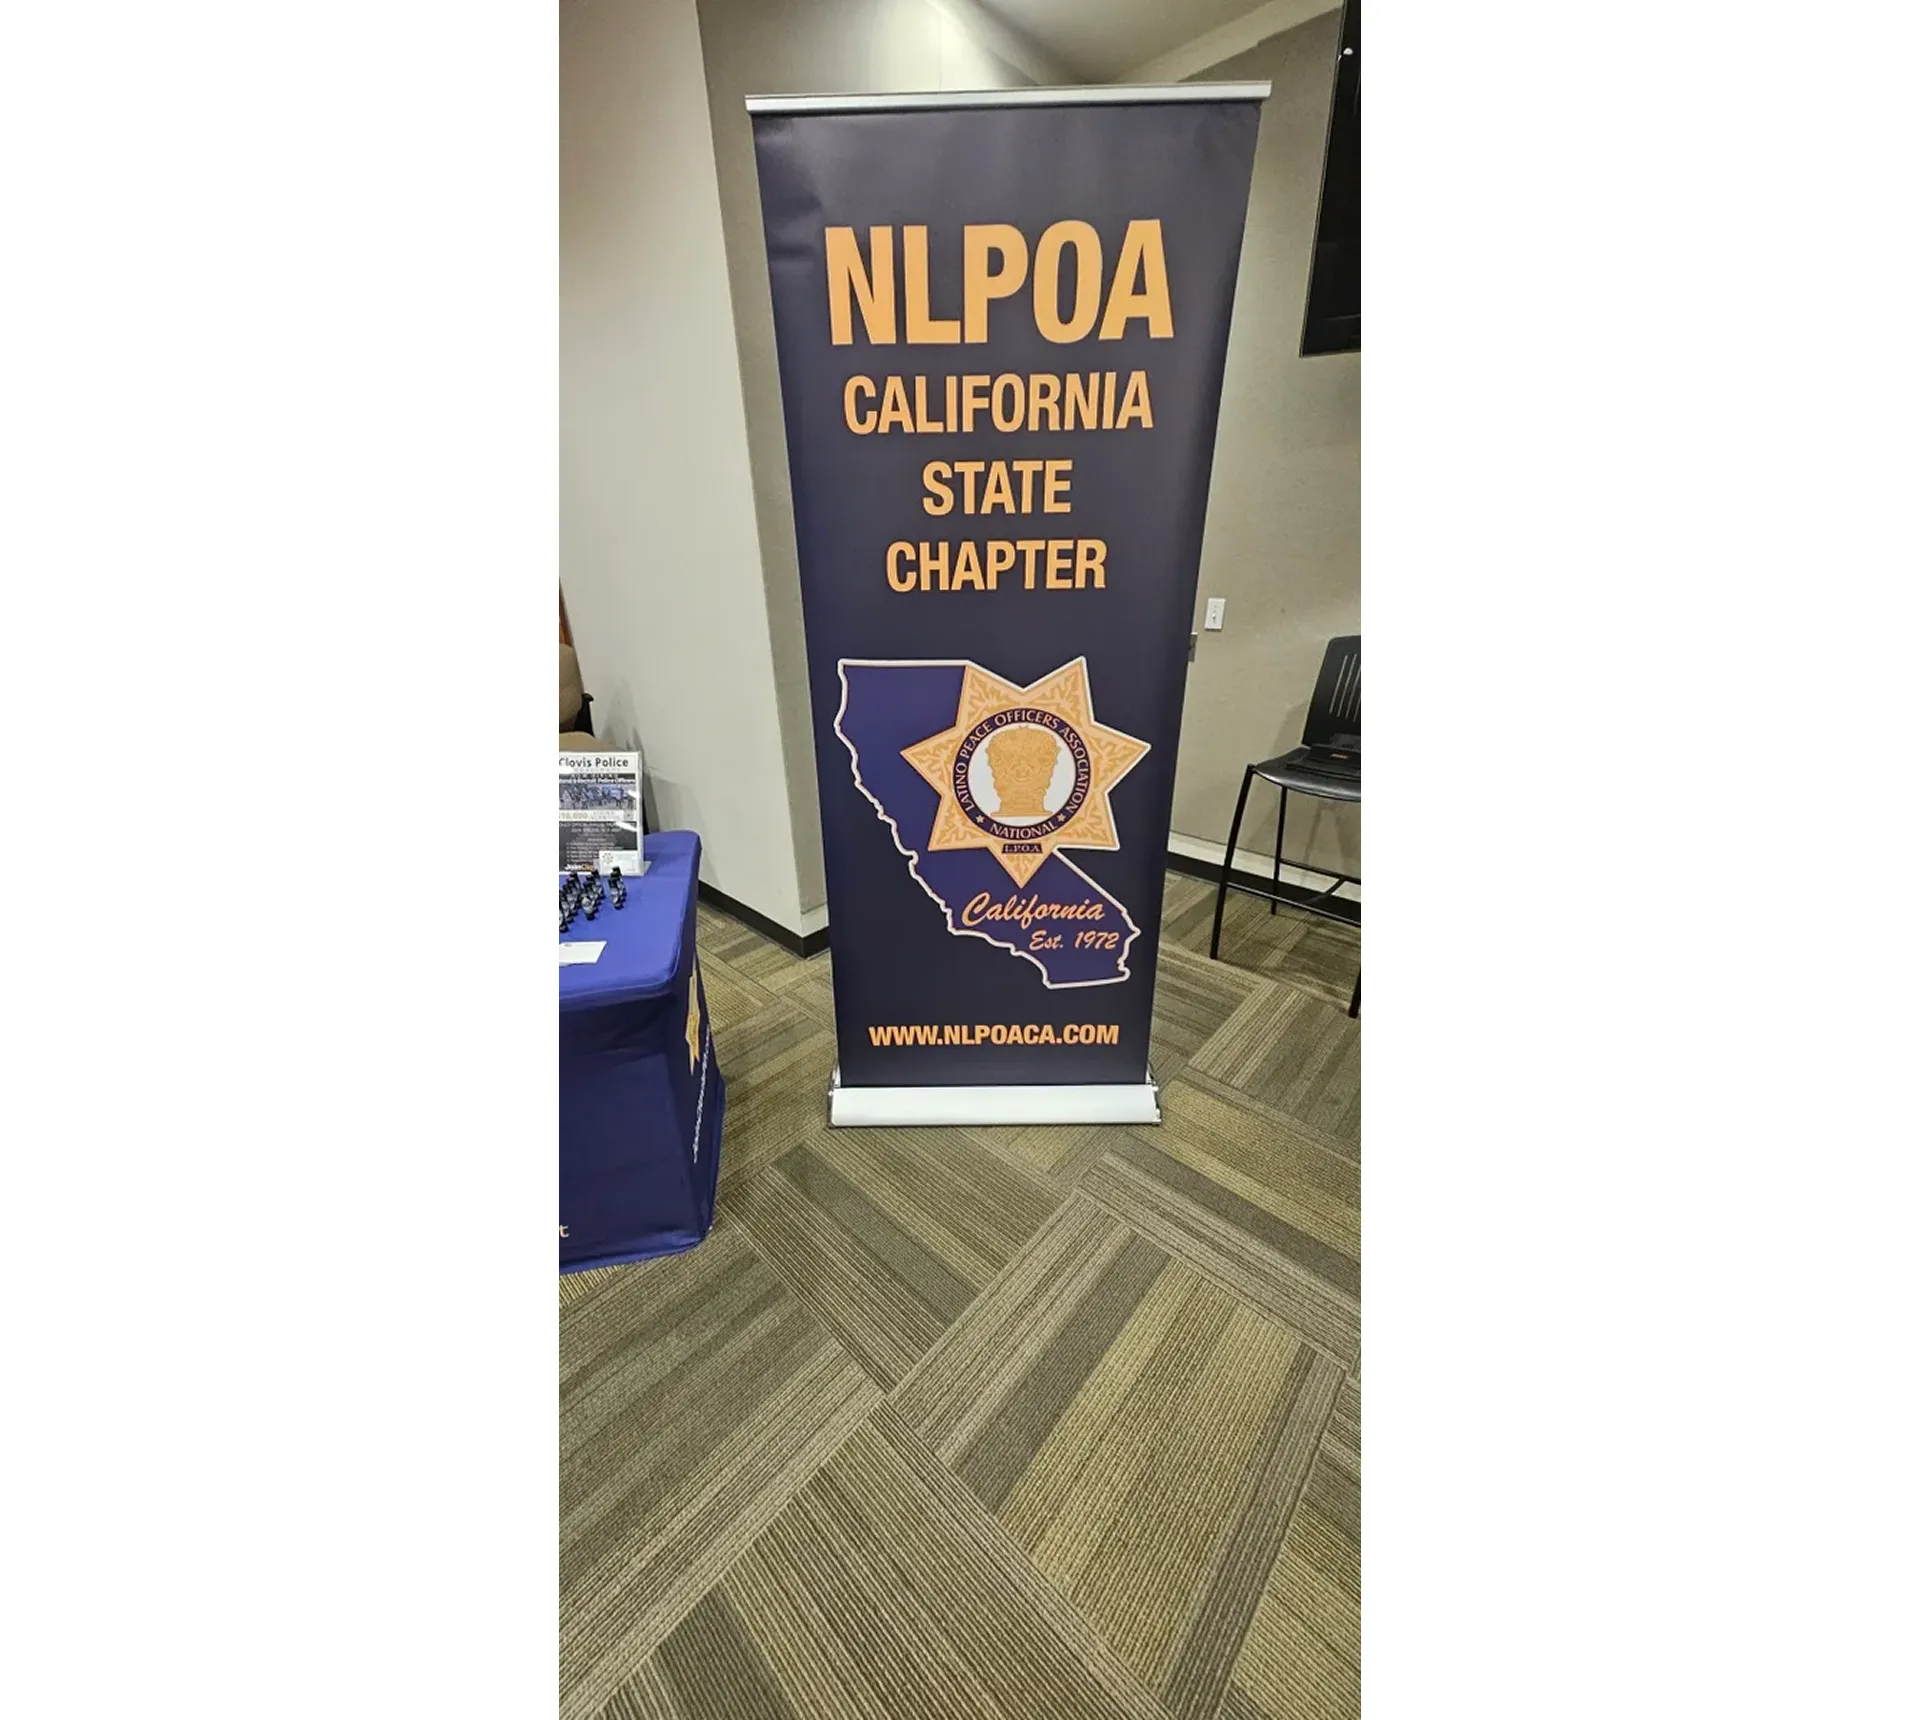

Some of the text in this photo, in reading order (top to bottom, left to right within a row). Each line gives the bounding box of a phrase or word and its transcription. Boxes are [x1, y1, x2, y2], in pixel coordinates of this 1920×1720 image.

[825, 219, 1174, 345] NLPOA
[843, 371, 1154, 435] CALIFORNIA
[922, 459, 1073, 516] STATE
[886, 539, 1108, 592] CHAPTER
[595, 757, 629, 767] Police
[955, 709, 1089, 814] LATINO PEACE OFFICERS ASSOCIATION
[989, 820, 1058, 839] NATIONAL
[961, 891, 1106, 930] California
[1029, 930, 1120, 950] Est. 1972
[868, 1024, 1120, 1046] WWW.NLPOACA.COM
